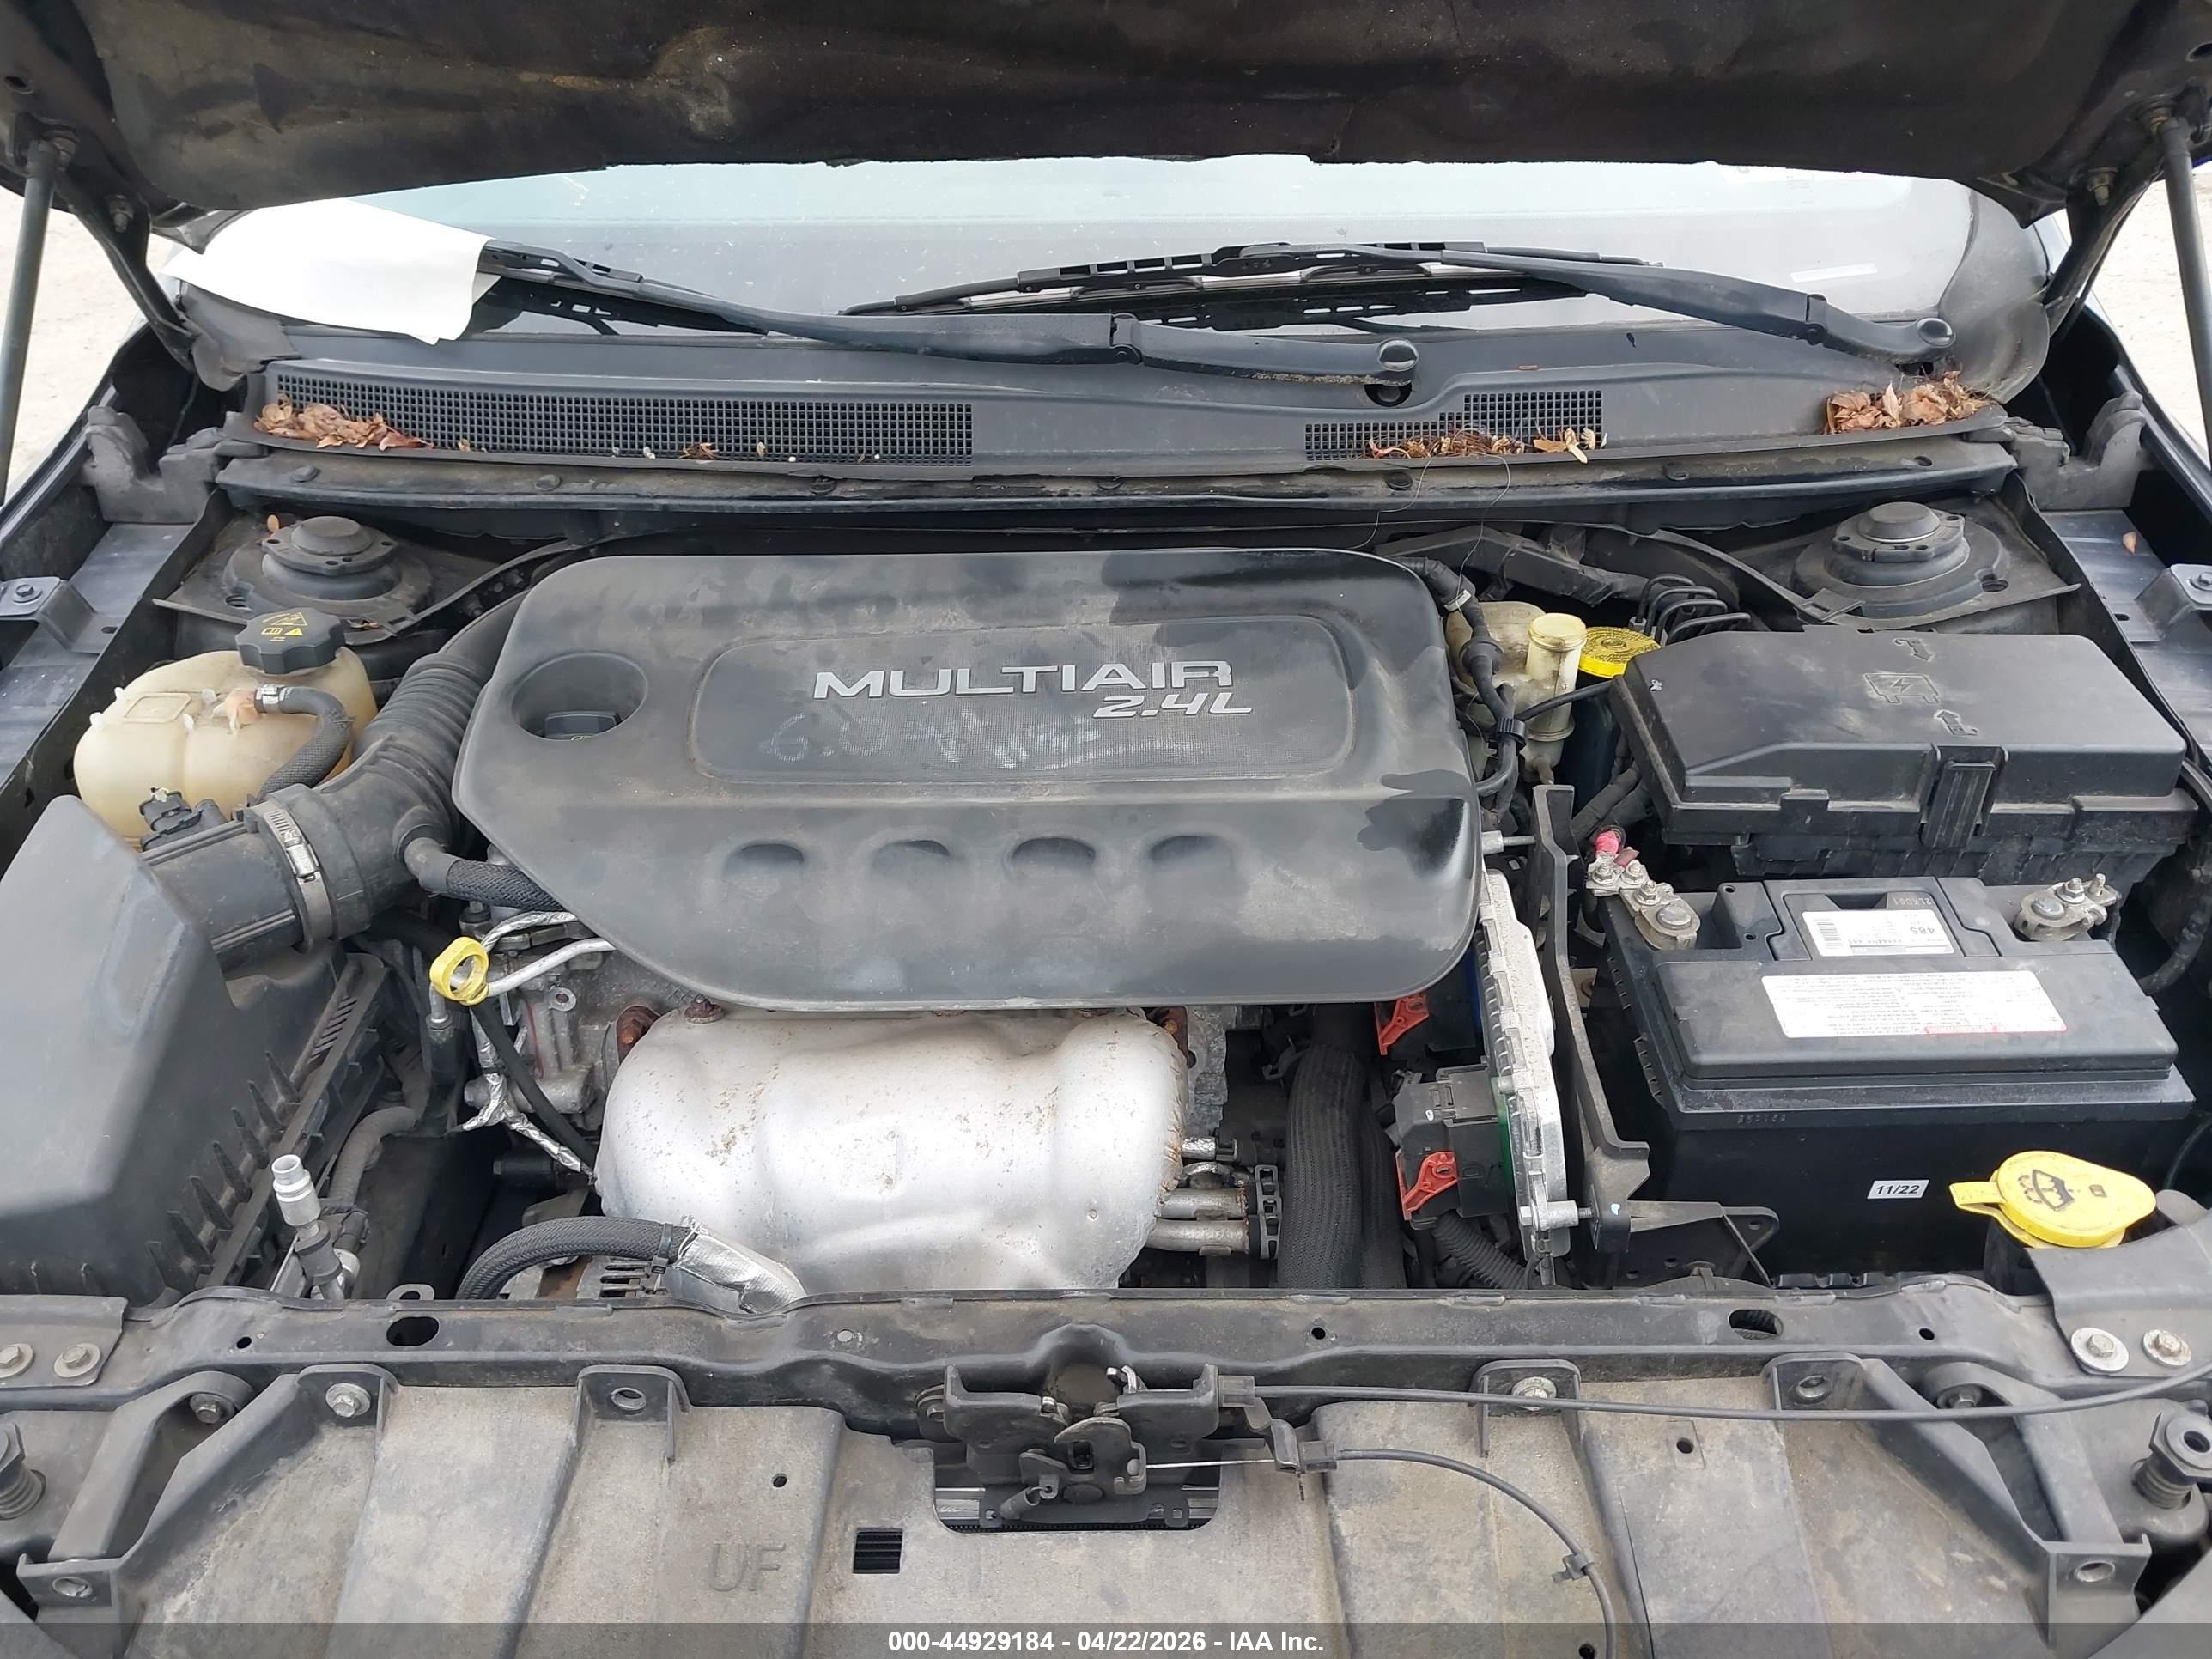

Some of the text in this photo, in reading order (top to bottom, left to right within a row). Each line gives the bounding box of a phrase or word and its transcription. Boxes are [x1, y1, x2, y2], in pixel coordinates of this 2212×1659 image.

[812, 660, 1233, 699] MULTIAIR
[1091, 692, 1254, 719] 2.4L
[1877, 1185, 1920, 1194] 11/22
[708, 1542, 787, 1592] UF
